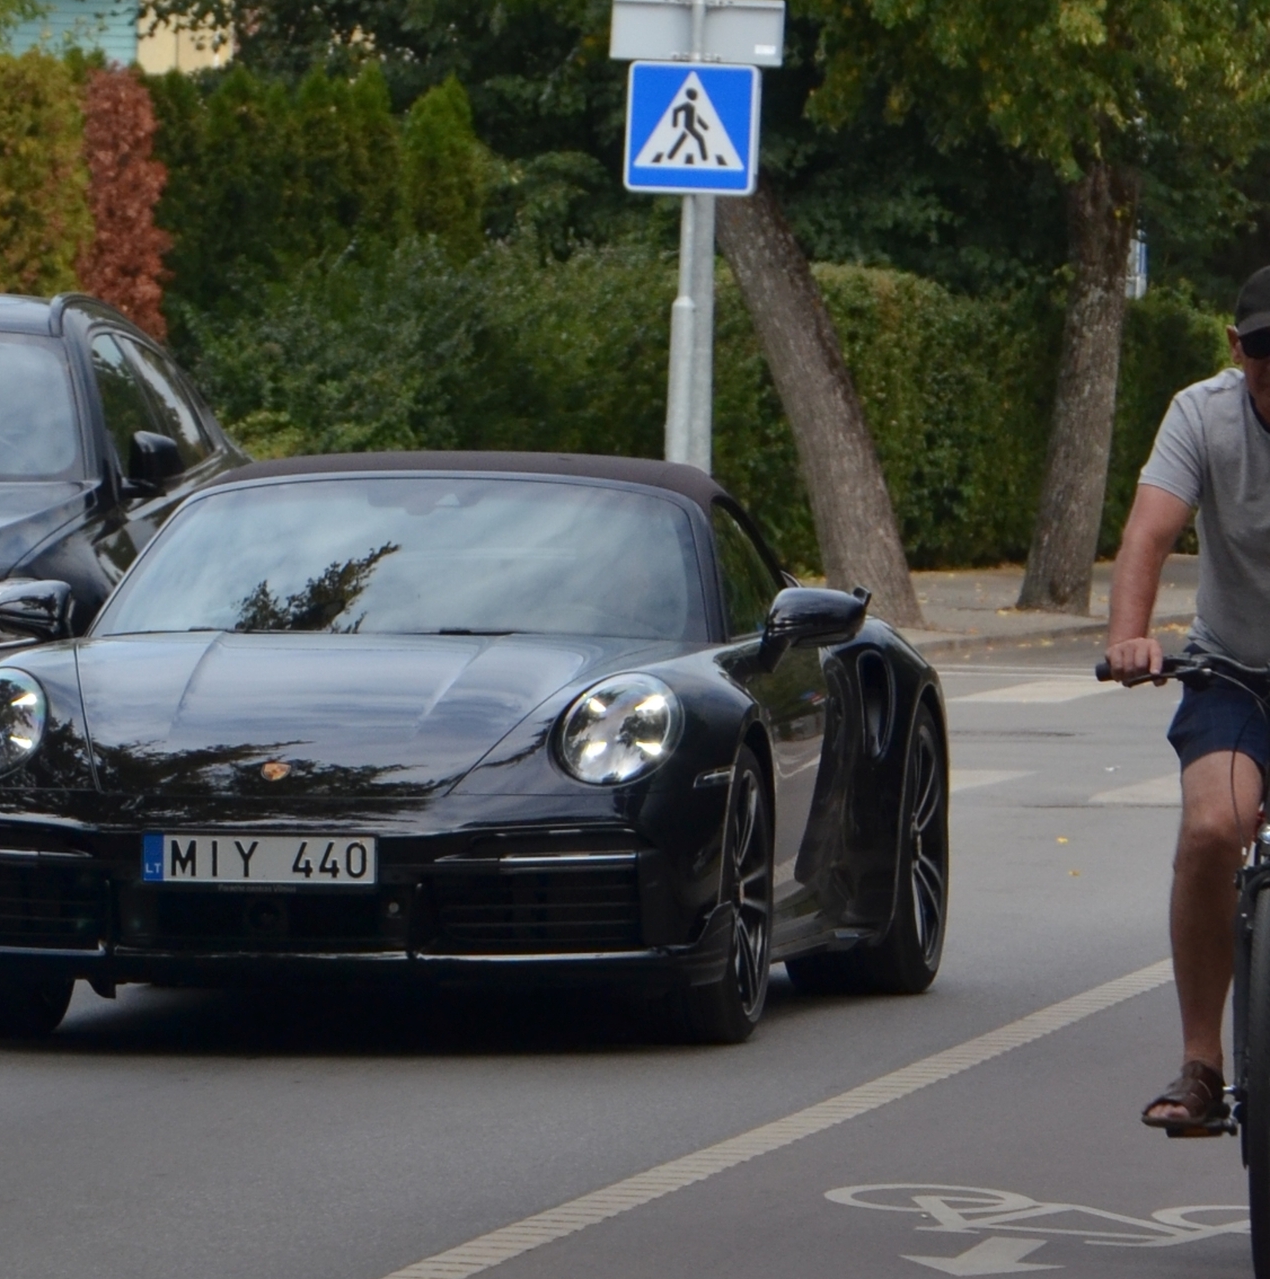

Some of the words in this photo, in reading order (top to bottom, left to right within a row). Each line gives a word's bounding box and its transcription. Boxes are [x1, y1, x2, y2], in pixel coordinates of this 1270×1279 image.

[145, 863, 162, 874] LT
[170, 840, 259, 878] MIY
[292, 841, 368, 879] 440
